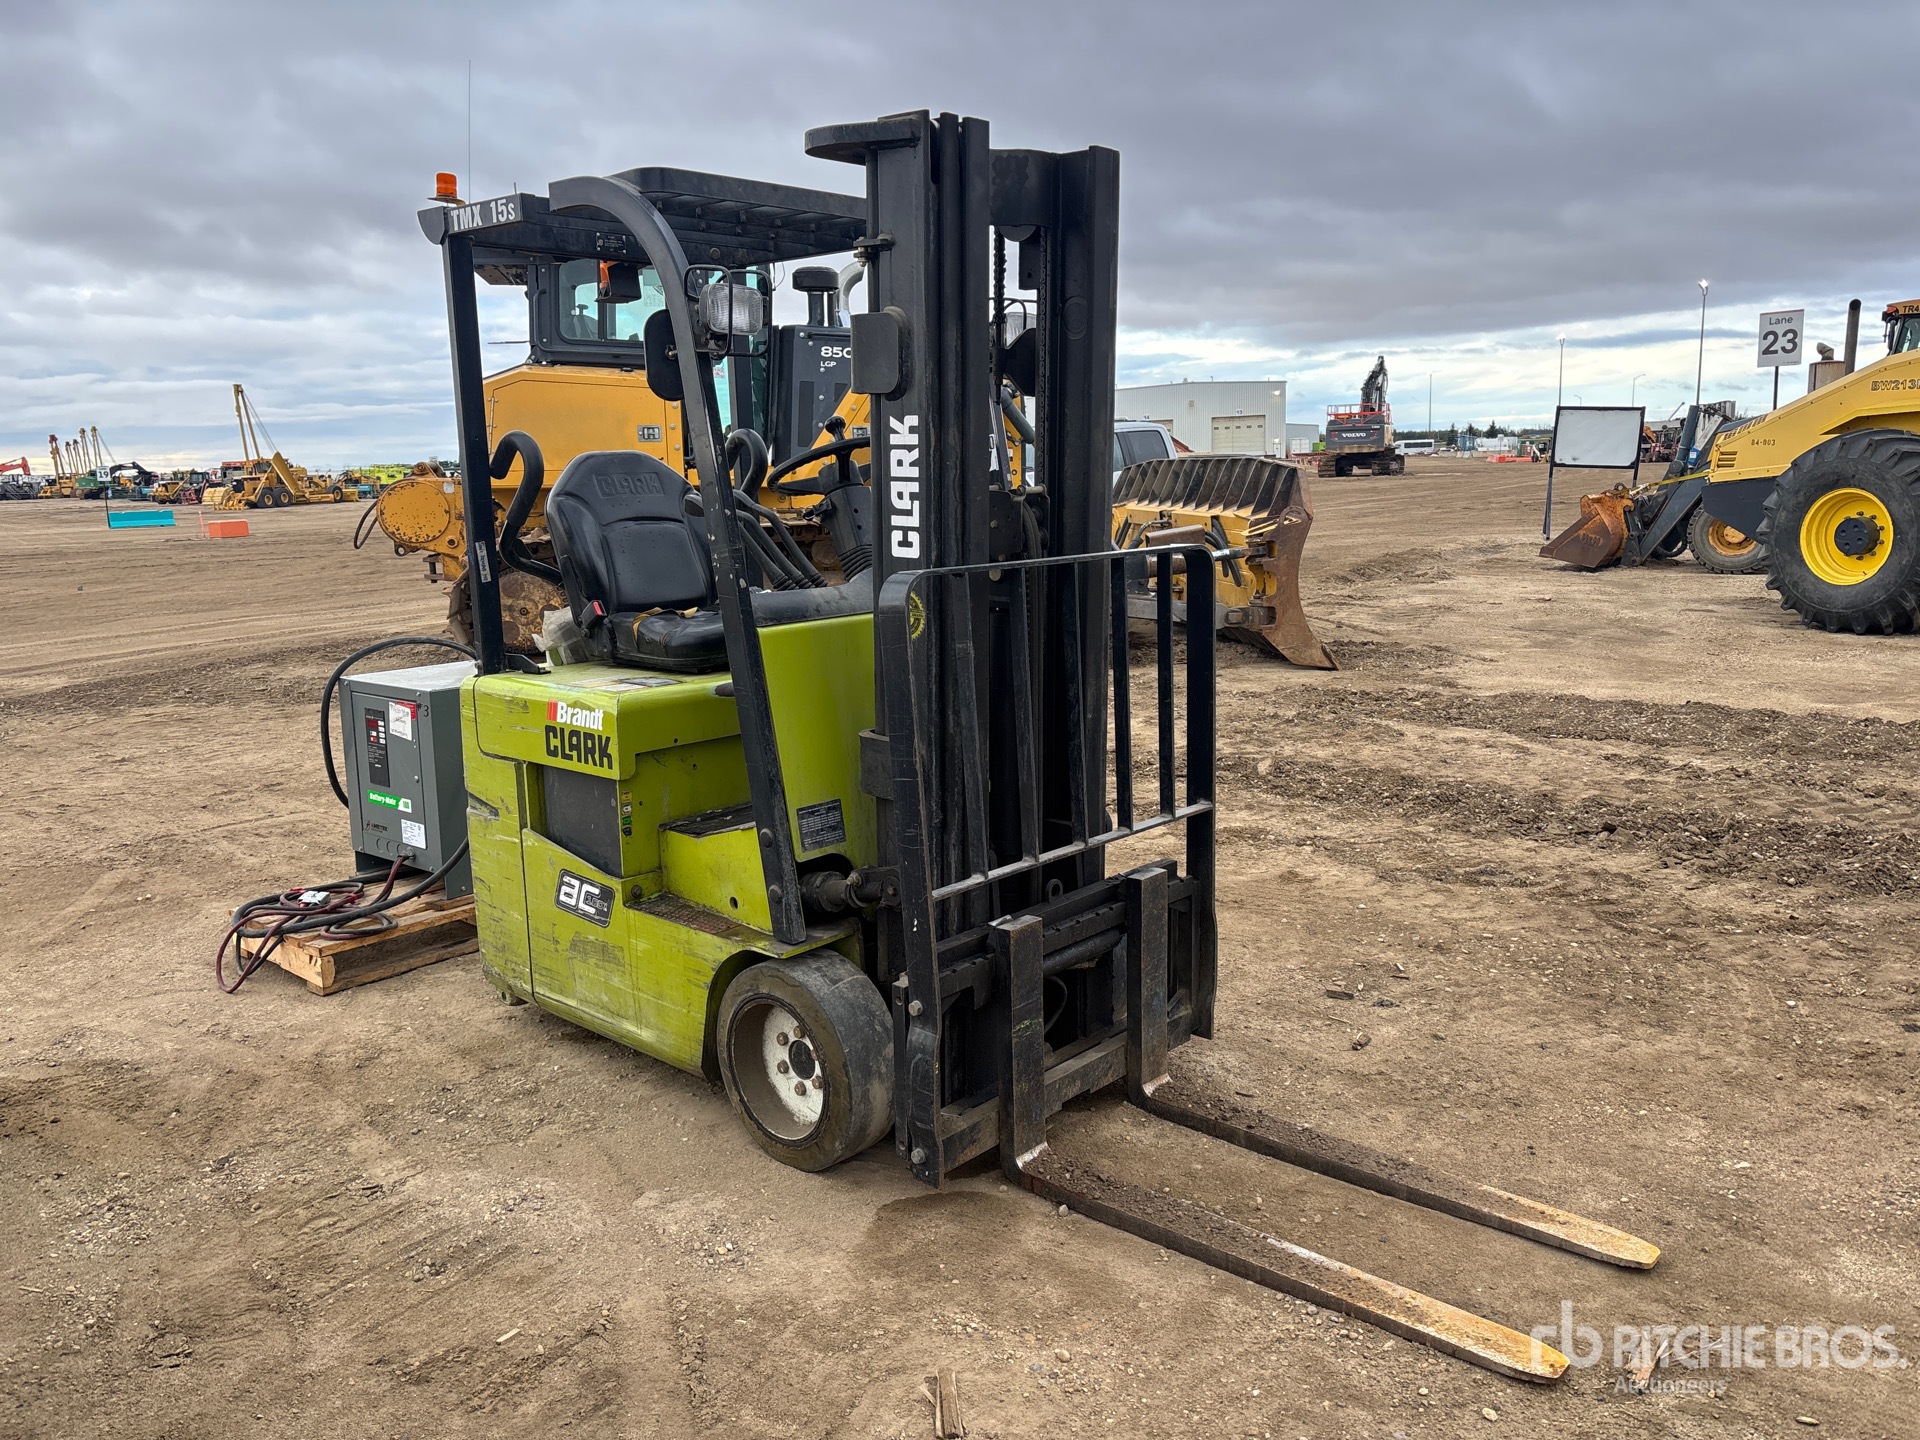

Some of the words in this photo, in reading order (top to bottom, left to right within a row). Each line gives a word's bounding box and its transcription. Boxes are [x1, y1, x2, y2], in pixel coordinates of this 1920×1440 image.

[451, 204, 483, 231] TMX
[489, 198, 516, 223] 15s
[1769, 316, 1793, 325] Lane
[1762, 328, 1799, 355] 23
[597, 473, 662, 497] CLARK
[889, 414, 920, 559] CLARK
[556, 701, 604, 731] Brandt
[544, 724, 613, 770] CLARK
